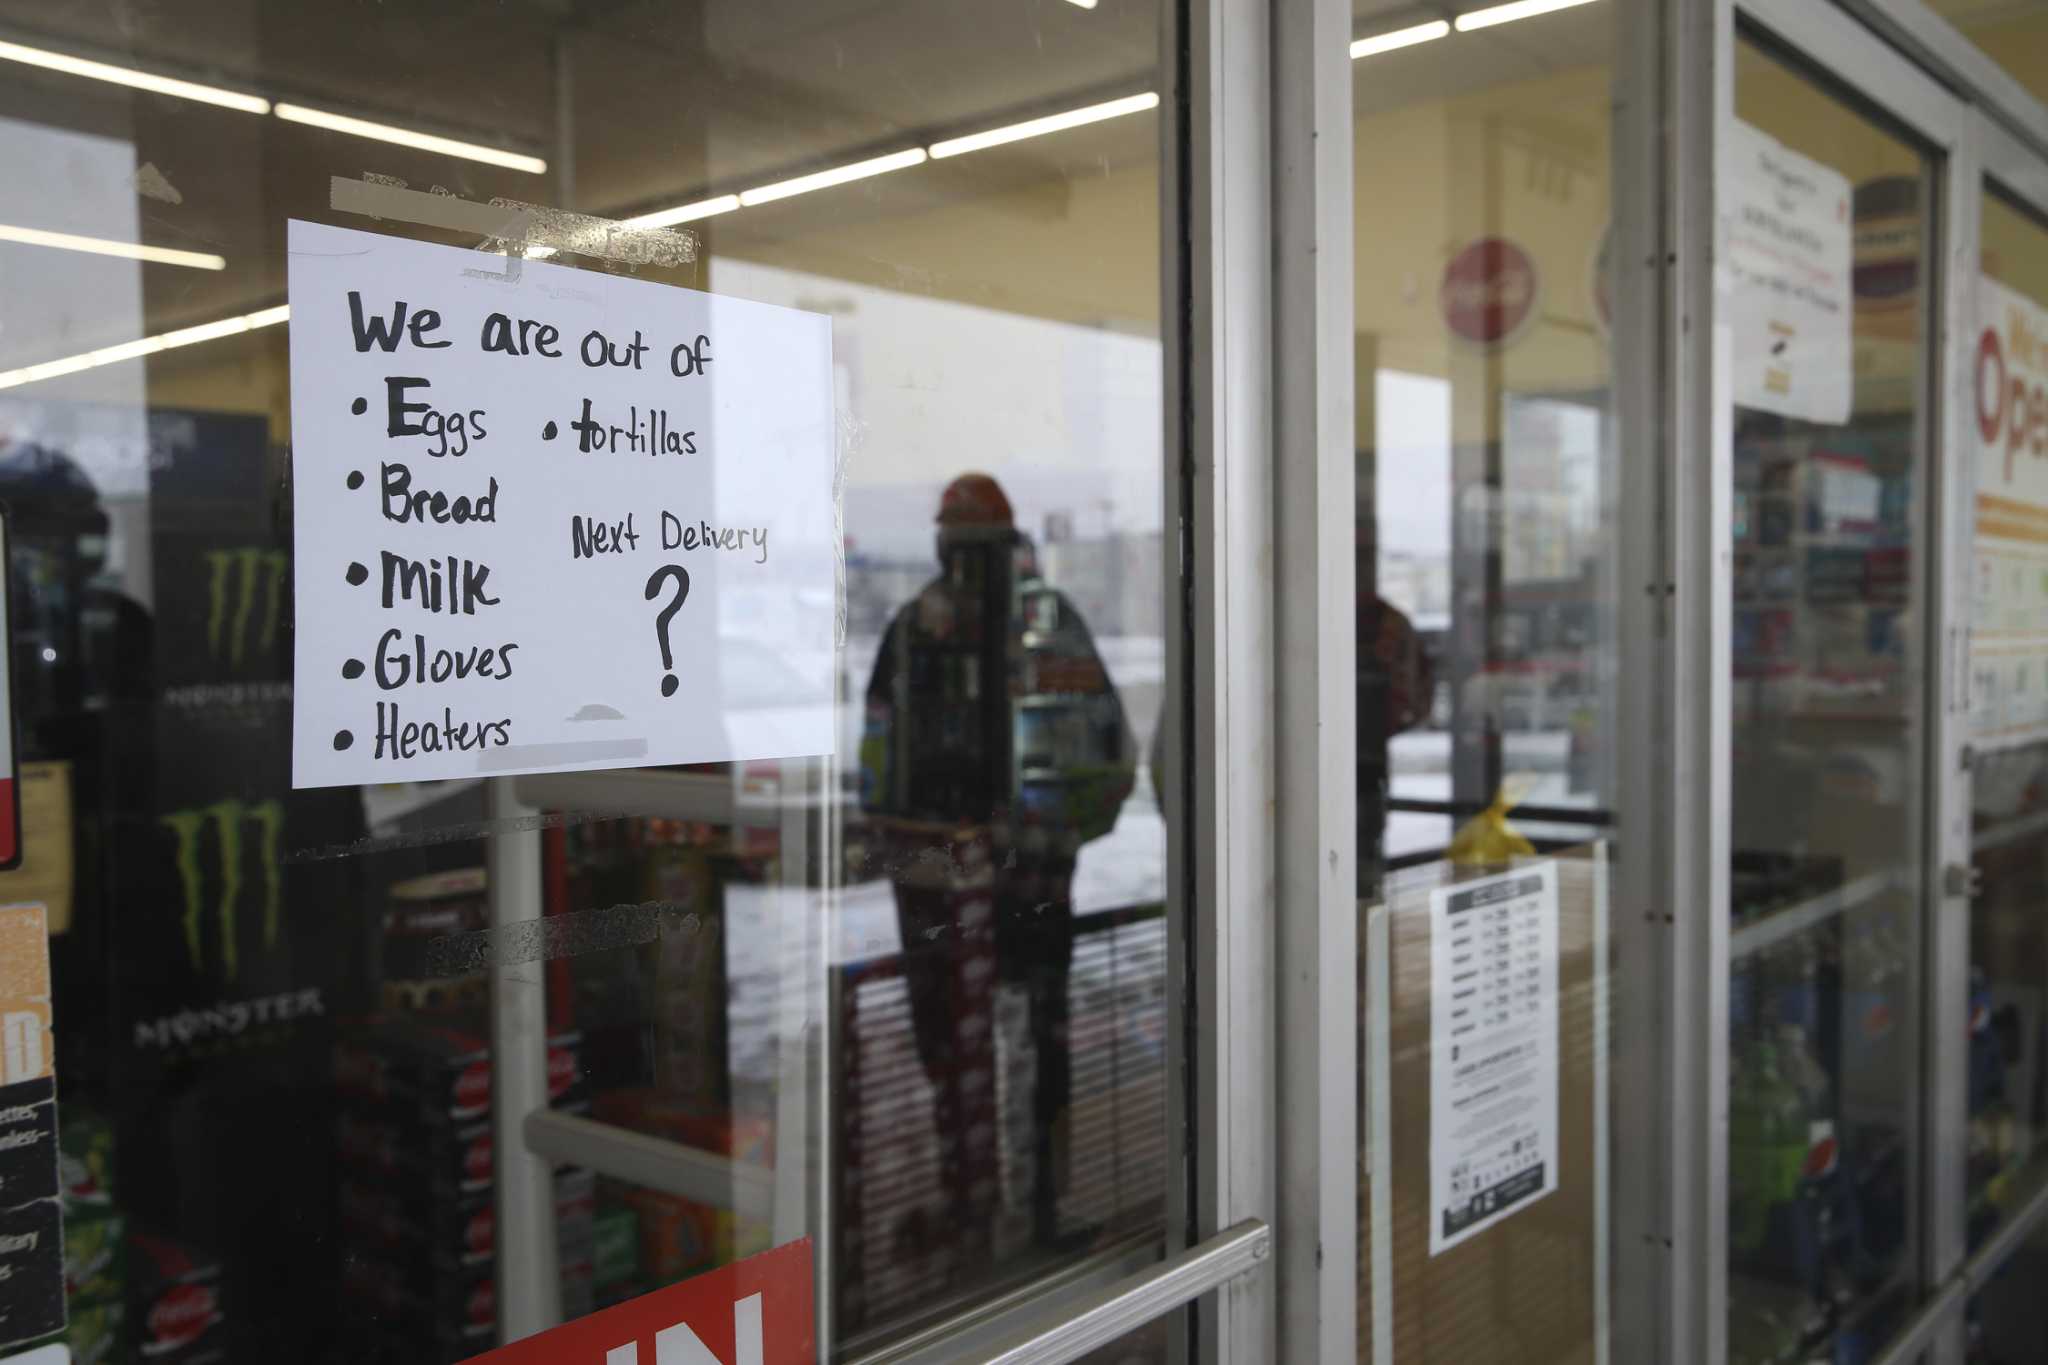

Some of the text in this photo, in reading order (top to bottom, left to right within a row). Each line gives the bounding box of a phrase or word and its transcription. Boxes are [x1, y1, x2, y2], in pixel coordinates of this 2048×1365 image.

[347, 291, 453, 353] We
[480, 312, 563, 358] are
[670, 334, 713, 378] of
[383, 376, 487, 457] Eggs
[570, 398, 697, 457] tortillas
[381, 461, 499, 525] Bread
[572, 509, 767, 564] Next Delivery
[374, 628, 519, 691] Gloves
[644, 564, 690, 698] ?
[374, 701, 512, 761] Heaters
